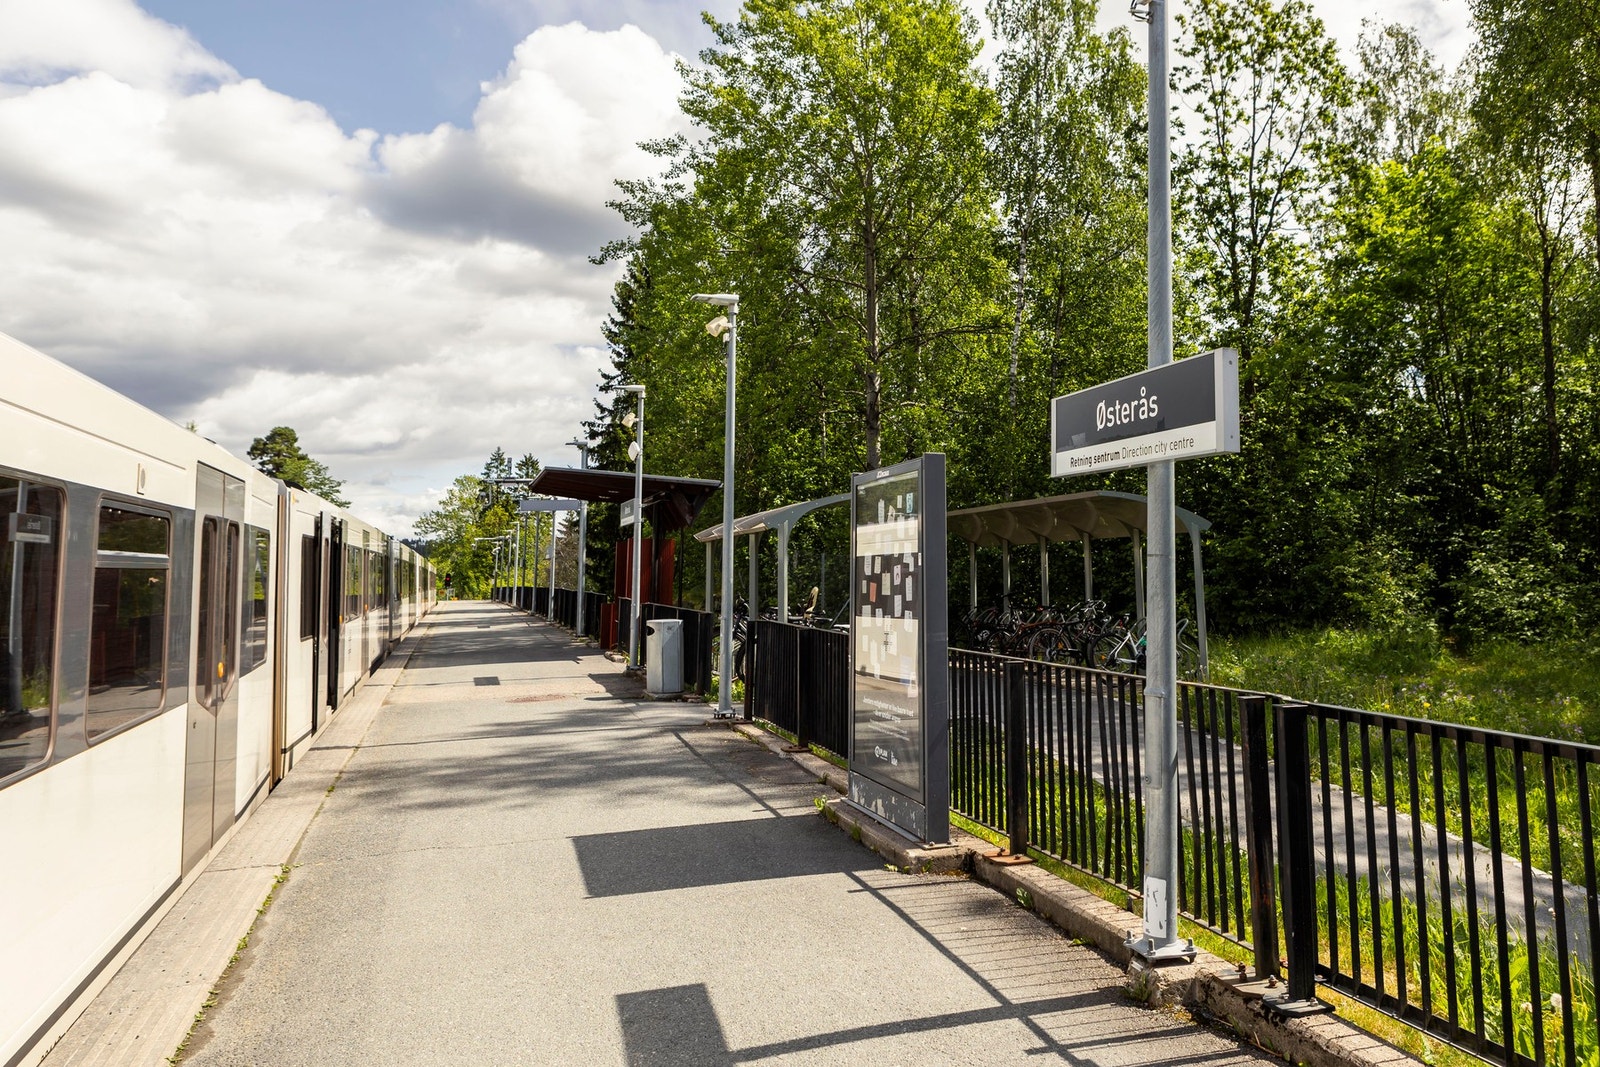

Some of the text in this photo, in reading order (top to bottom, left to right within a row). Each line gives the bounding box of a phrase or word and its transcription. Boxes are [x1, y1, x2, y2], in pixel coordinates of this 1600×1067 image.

[1096, 386, 1158, 431] Østerås
[1070, 437, 1194, 468] Retning sentrum Direction city centre
